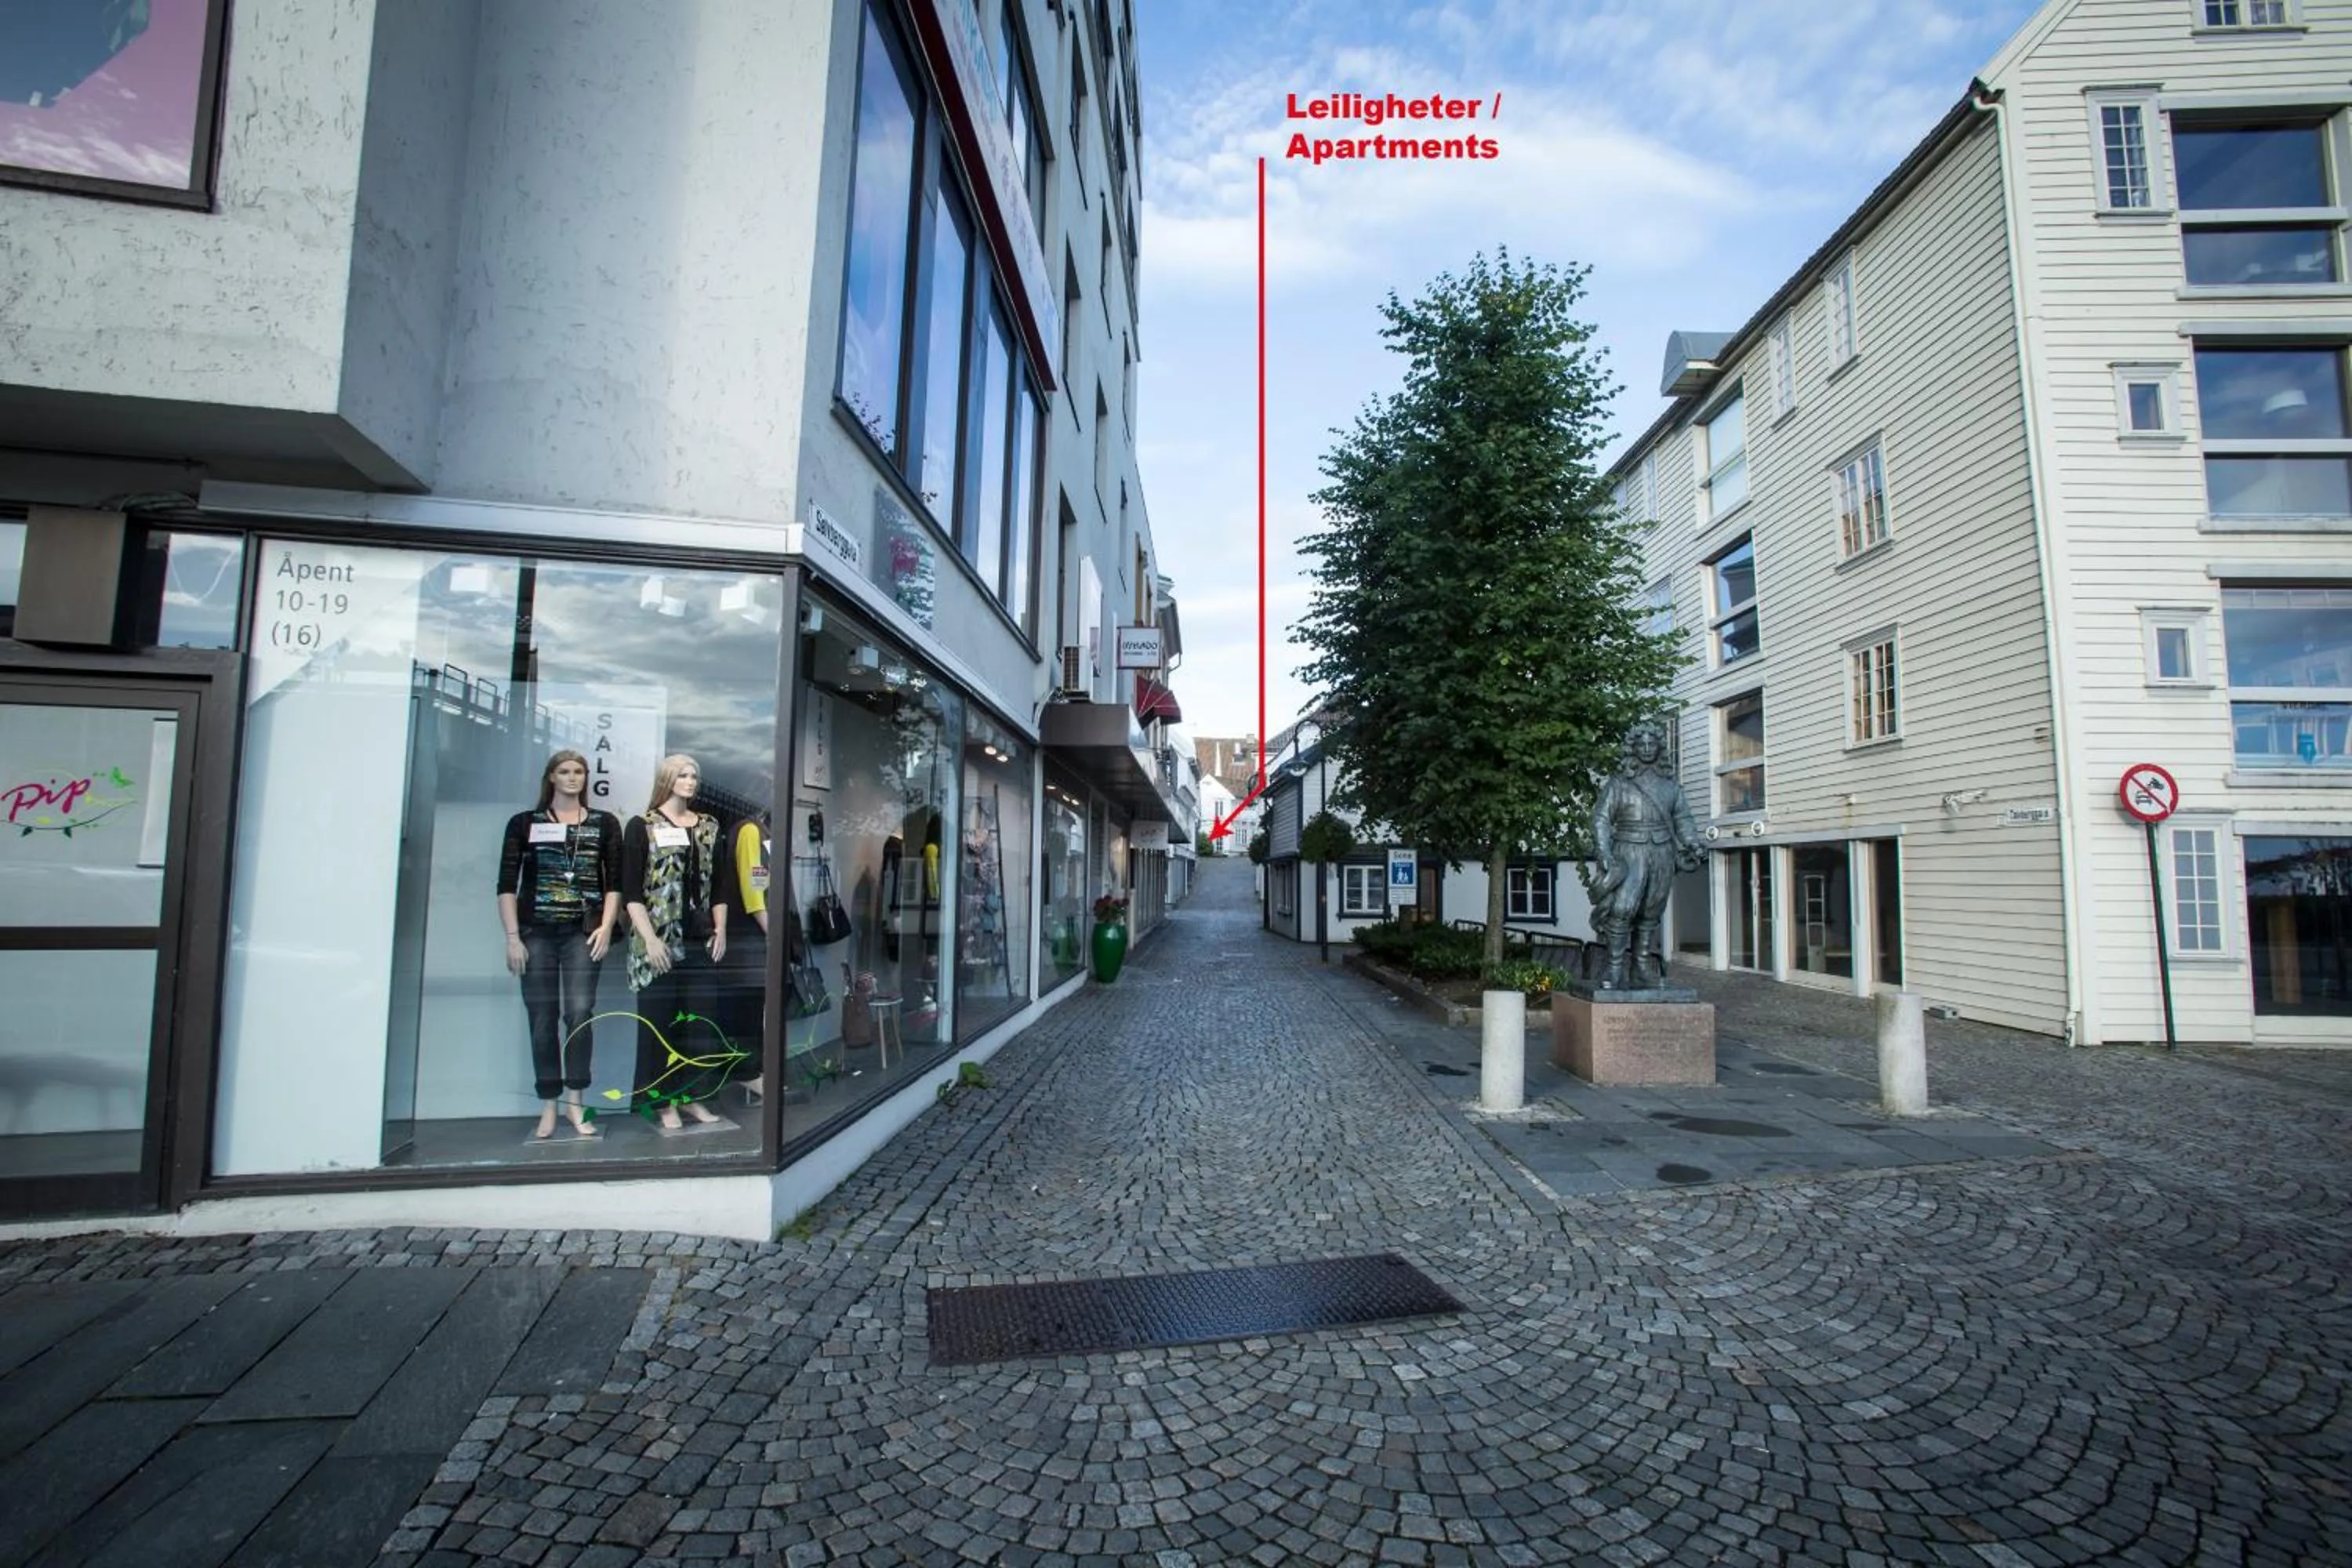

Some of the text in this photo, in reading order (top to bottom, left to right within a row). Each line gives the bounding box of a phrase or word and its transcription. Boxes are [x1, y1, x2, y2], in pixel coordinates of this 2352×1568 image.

[277, 551, 354, 584] Åpent
[276, 590, 348, 615] 10-19
[272, 621, 321, 648] (16)
[593, 713, 612, 797] SALG
